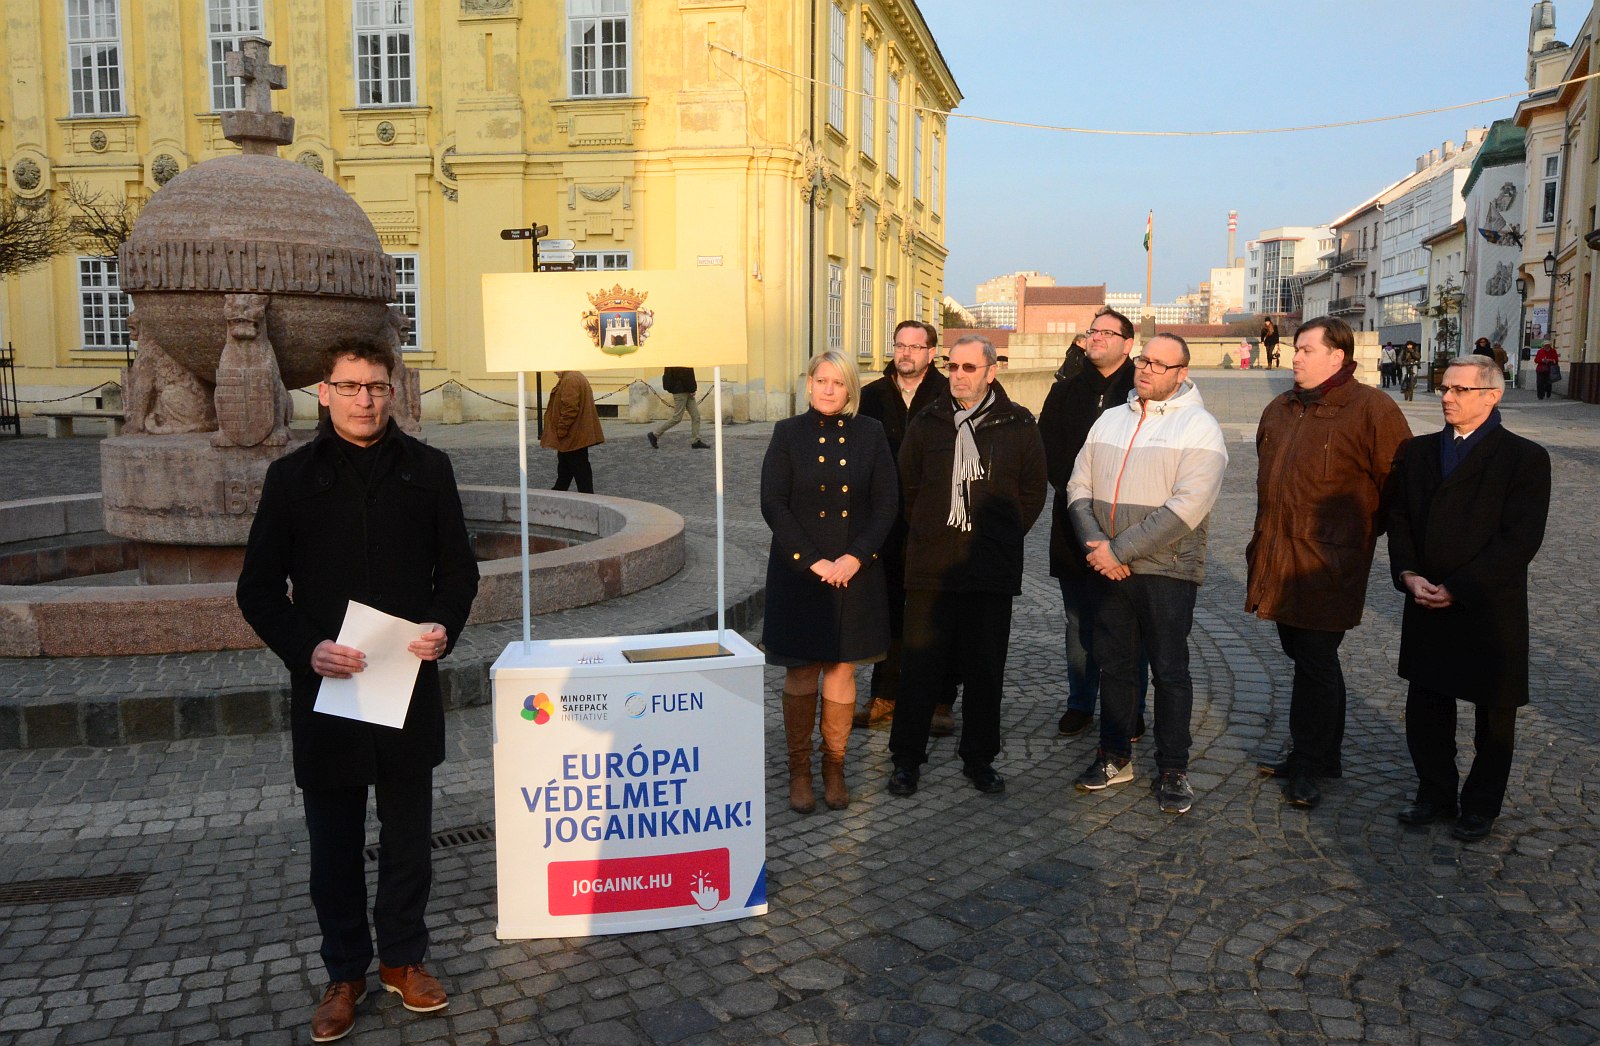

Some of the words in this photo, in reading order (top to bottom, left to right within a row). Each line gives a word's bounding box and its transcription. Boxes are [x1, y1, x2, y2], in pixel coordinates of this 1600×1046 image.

[560, 693, 608, 703] MINORITY
[562, 703, 608, 712] SAFEPACK
[651, 691, 704, 714] FUEN
[561, 712, 608, 722] INITIATIVE
[562, 743, 700, 781] EURÓPAI
[520, 778, 688, 813] VÉDELMET
[543, 800, 752, 849] JOGAINKNAK!
[572, 872, 673, 897] JOGAINK.HU
